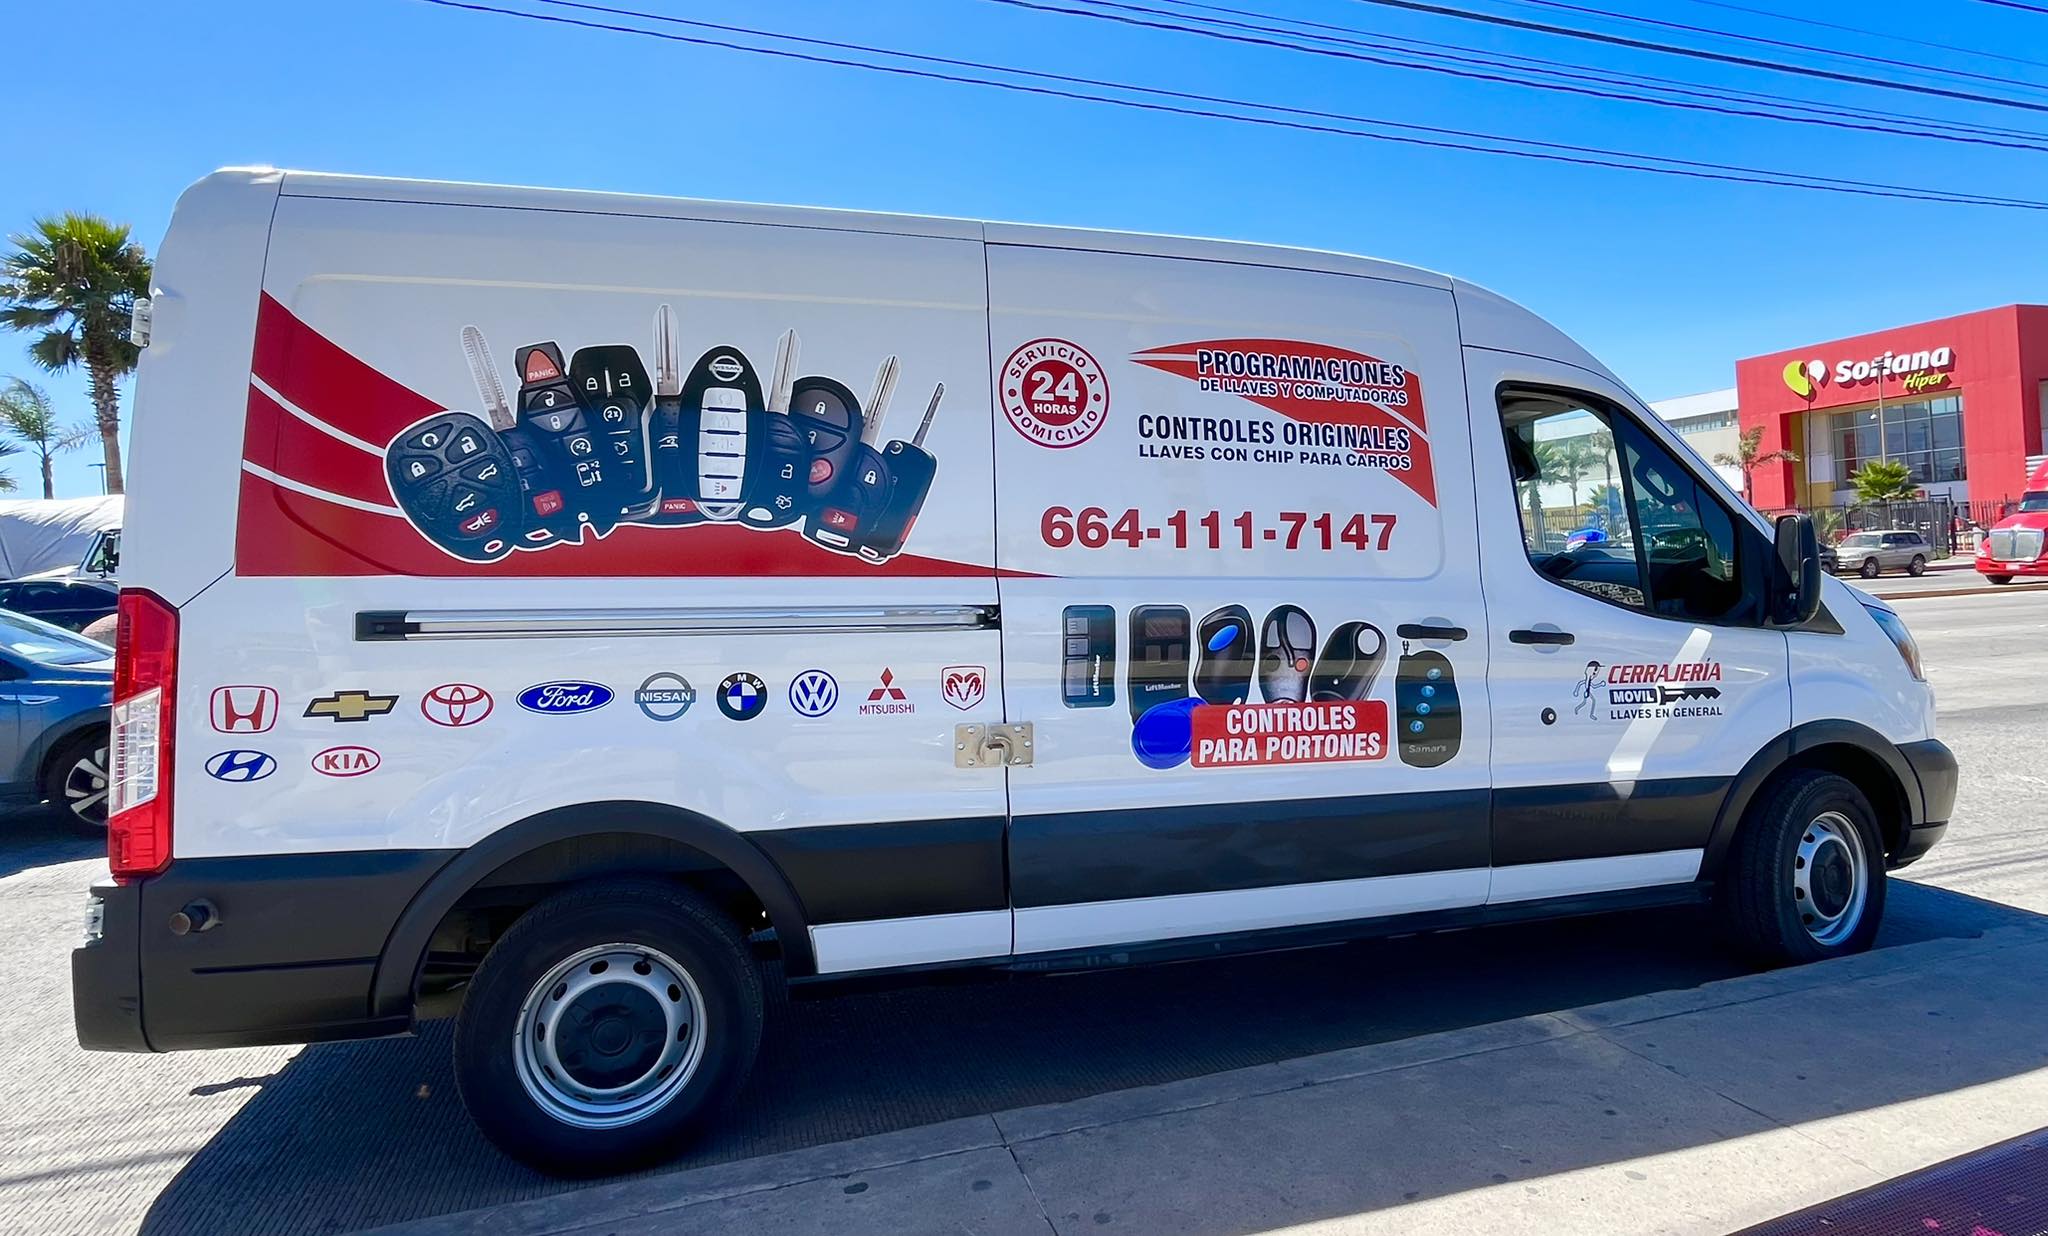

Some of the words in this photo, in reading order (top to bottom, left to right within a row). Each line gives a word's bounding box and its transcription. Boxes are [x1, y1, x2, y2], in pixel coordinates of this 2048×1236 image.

[528, 368, 555, 380] PANIC
[1010, 345, 1086, 378] SERVICIO
[1086, 372, 1098, 384] A
[1198, 350, 1405, 387] PROGRAMACIONES
[1834, 347, 1951, 383] Soriana
[1031, 370, 1079, 403] 24
[1200, 379, 1220, 392] DE
[1224, 380, 1277, 397] LLAVES
[1281, 383, 1291, 397] Y
[1295, 385, 1408, 405] COMPUTADORAS
[1034, 403, 1078, 415] HORAS
[1012, 405, 1098, 441] DOMICILIO
[1138, 413, 1275, 444] CONTROLES
[1283, 422, 1410, 451] ORIGINALES
[1139, 444, 1205, 461] LLAVES
[1211, 447, 1248, 461] CON
[1253, 450, 1294, 464] CHIP
[1300, 451, 1342, 466] PARA
[1346, 453, 1411, 470] CARROS
[664, 502, 686, 511] PANIC
[1041, 505, 1397, 551] 664-111-7147
[1607, 658, 1721, 684] CERRAJERÍA
[537, 685, 593, 708] Ford
[640, 691, 691, 703] NISSAN
[1613, 690, 1655, 703] MOVIL
[859, 704, 915, 716] MITSUBISHI
[1226, 705, 1357, 735] CONTROLES
[1610, 708, 1652, 720] LLAVES
[1656, 708, 1670, 718] EN
[1673, 706, 1722, 717] GENERAL
[1199, 741, 1256, 763] PARA
[1267, 732, 1381, 760] PORTONES
[324, 754, 370, 770] KIA
